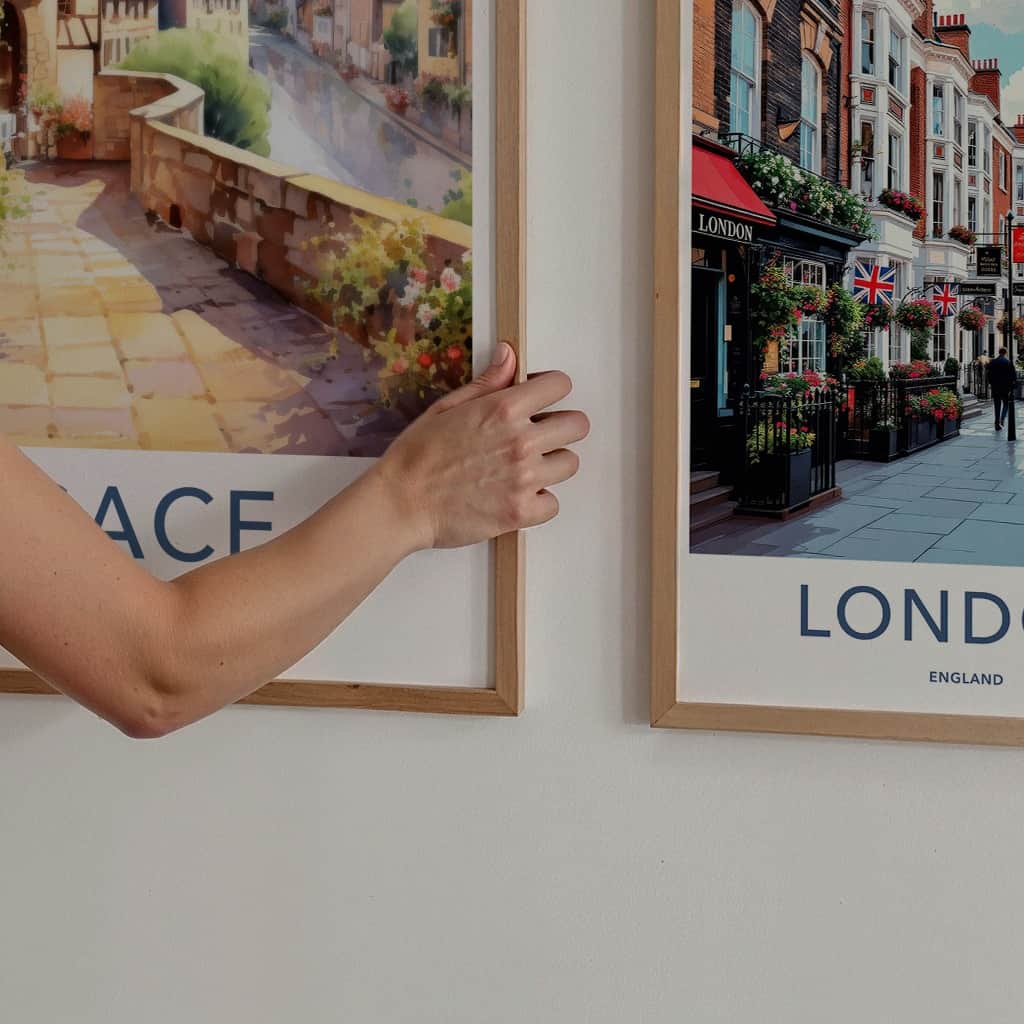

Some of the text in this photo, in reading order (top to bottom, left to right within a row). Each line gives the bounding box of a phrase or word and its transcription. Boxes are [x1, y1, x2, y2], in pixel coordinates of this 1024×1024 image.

[698, 213, 753, 242] LONDON
[800, 584, 1024, 644] LOND
[929, 671, 1004, 686] ENGLAND
